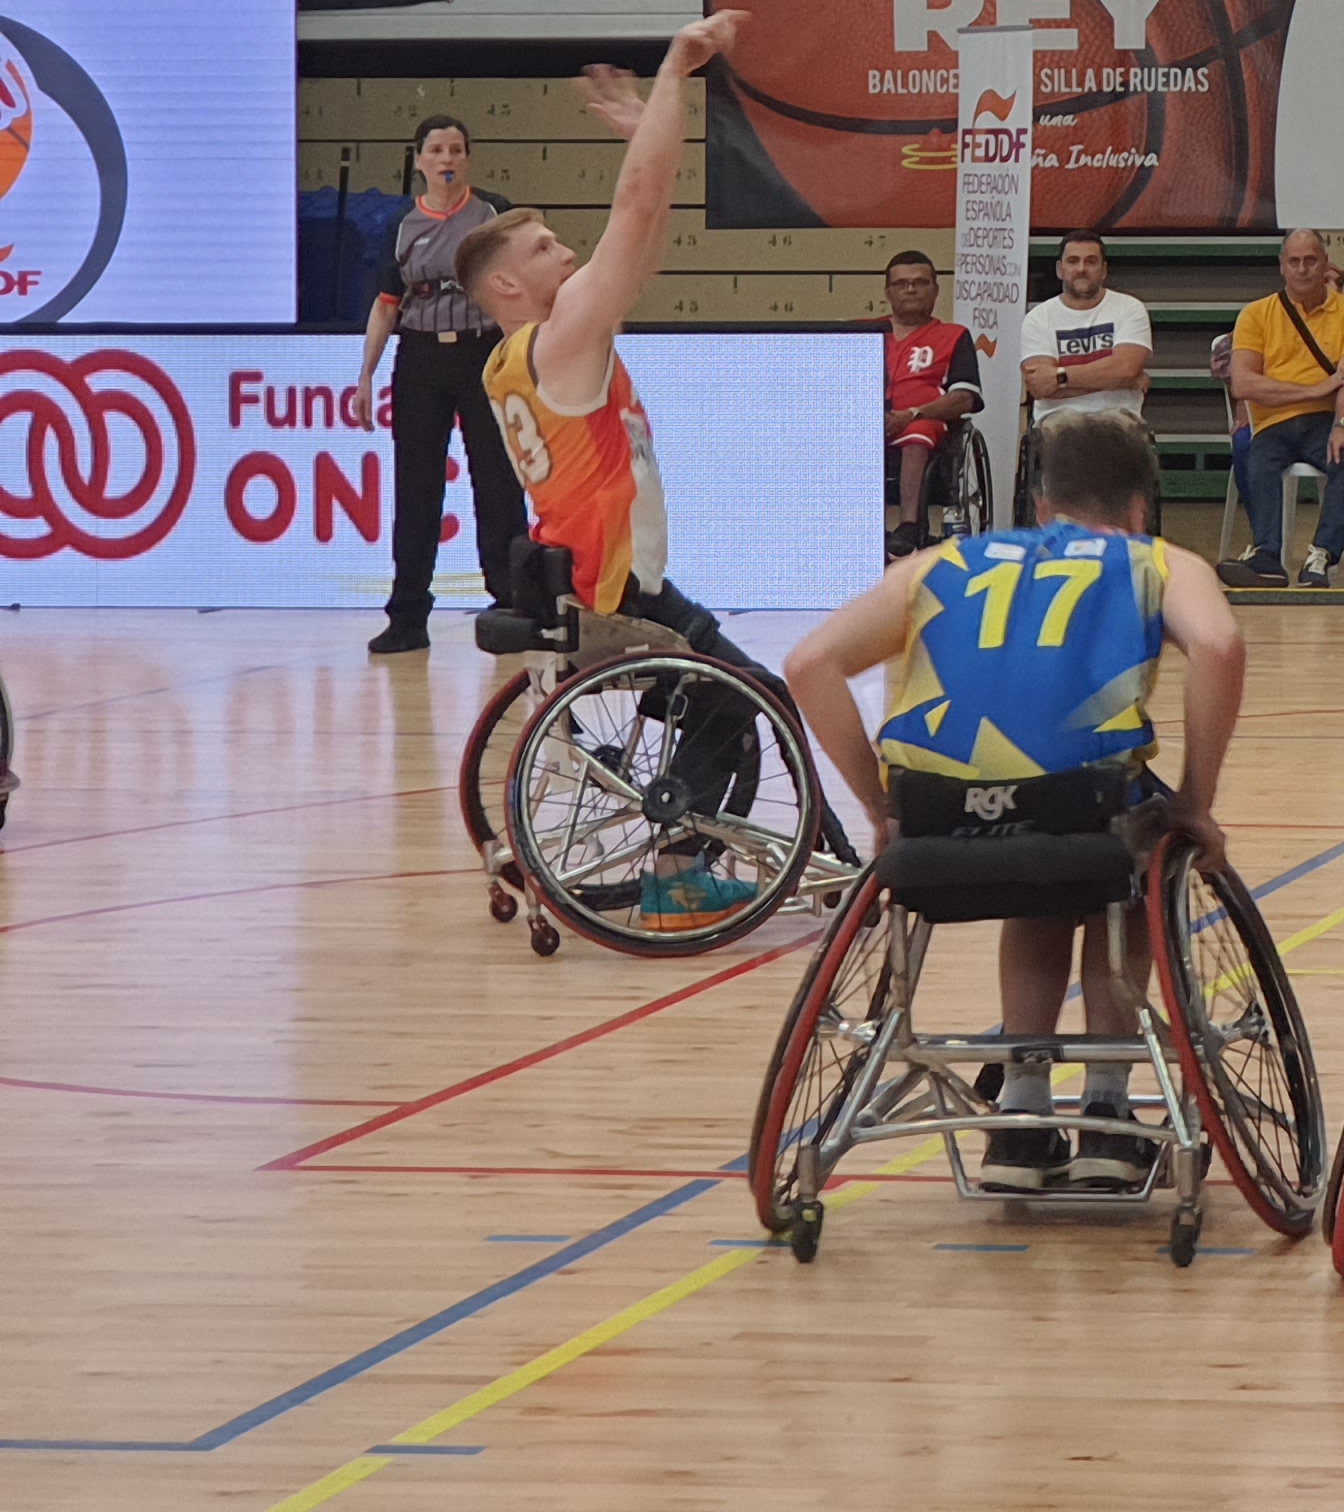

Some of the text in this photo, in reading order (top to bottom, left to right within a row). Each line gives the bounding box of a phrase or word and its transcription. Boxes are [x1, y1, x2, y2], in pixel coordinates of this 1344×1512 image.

[868, 68, 1209, 94] BALONCE SILLA DE RUEDAS
[1040, 111, 1078, 127] una
[961, 128, 1028, 163] FEDDF
[1064, 144, 1159, 169] Inclusiva
[963, 169, 1019, 195] FEDERACIÓN
[965, 196, 1012, 222] ESPAÑOLA
[968, 228, 1015, 249] DEPORTES
[960, 253, 1007, 276] PERSONAS
[965, 559, 1102, 648] 17
